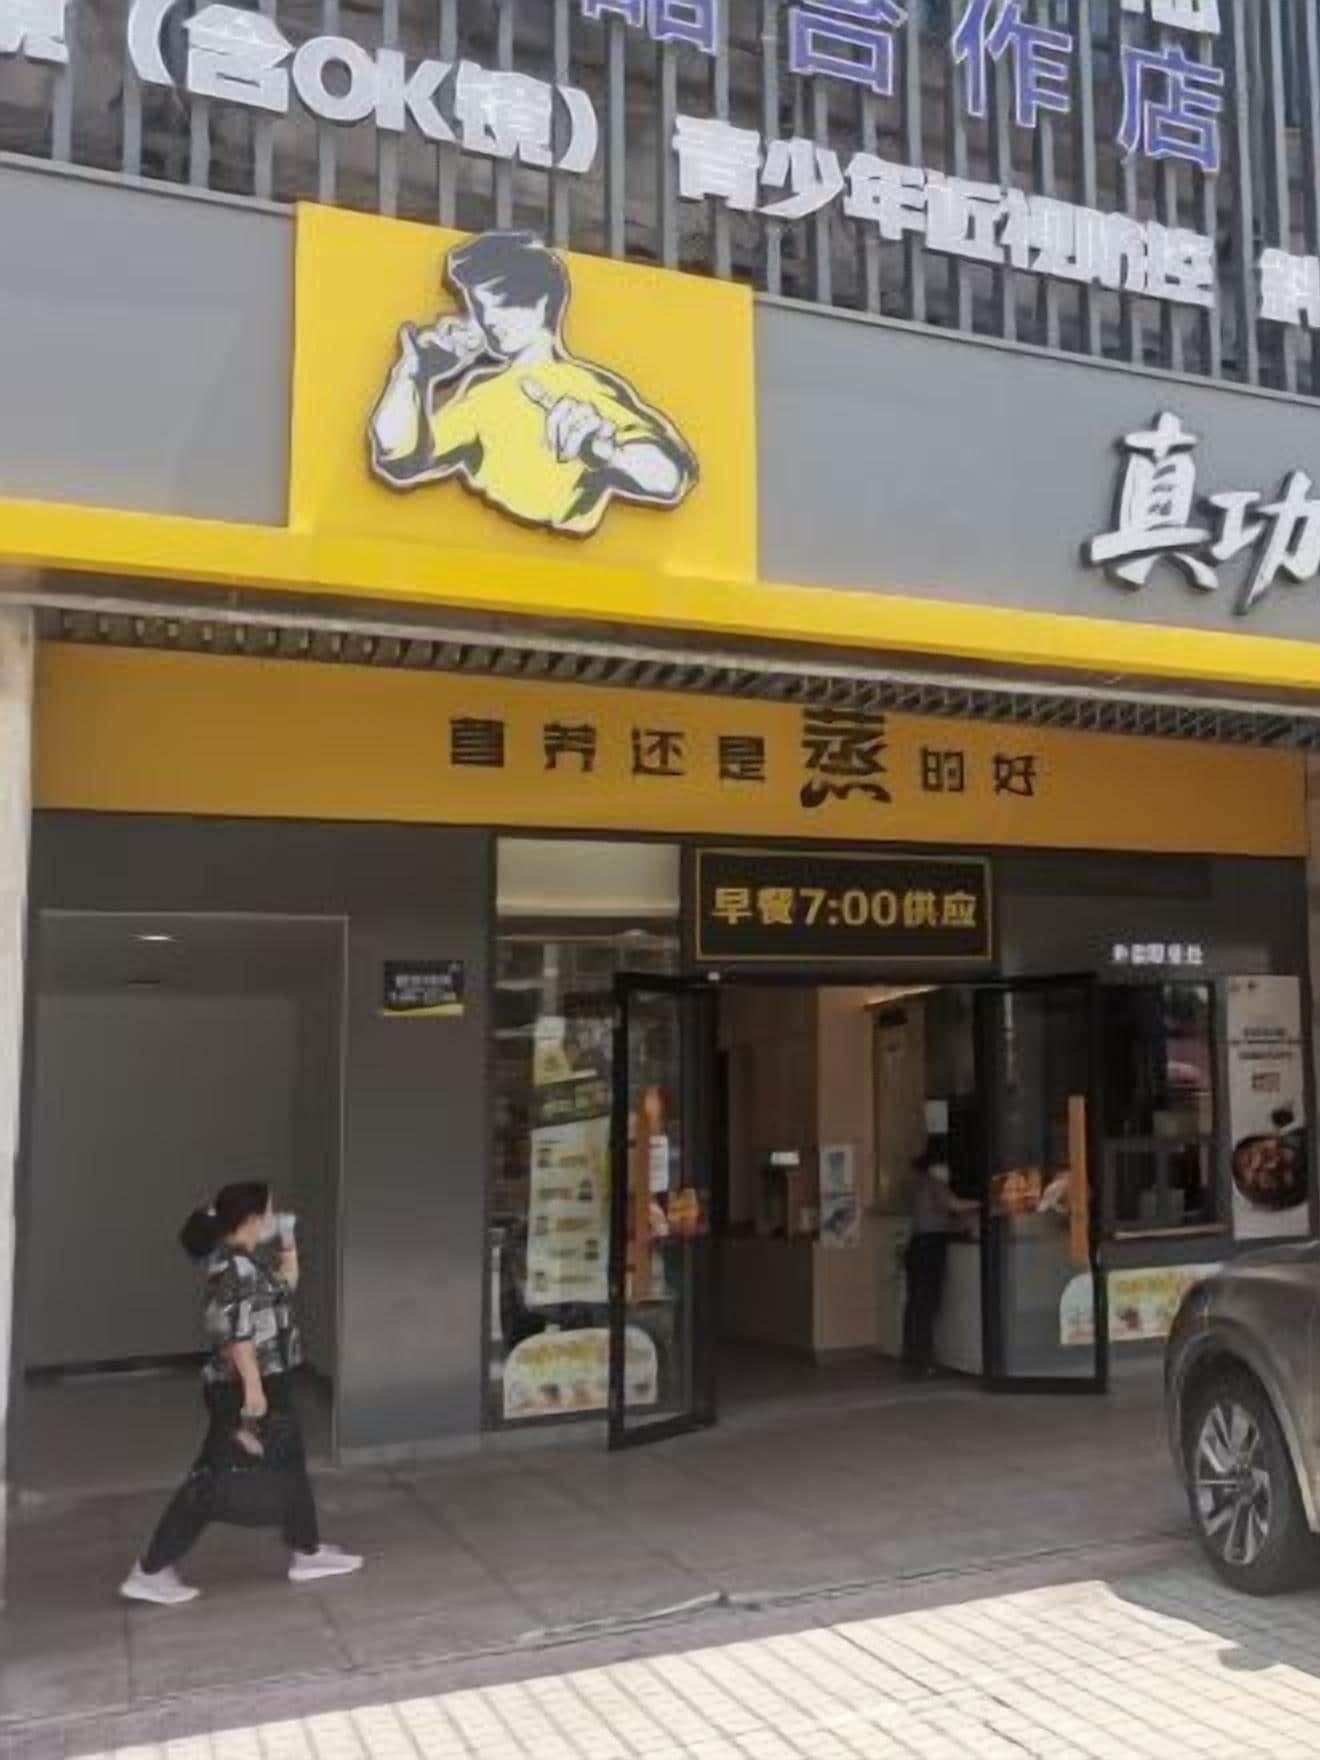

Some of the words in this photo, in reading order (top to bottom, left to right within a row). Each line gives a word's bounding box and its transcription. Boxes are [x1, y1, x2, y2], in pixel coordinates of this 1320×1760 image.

[448, 707, 1038, 808] 营养还是蒸的好
[712, 887, 977, 928] 早餐7:00供应
